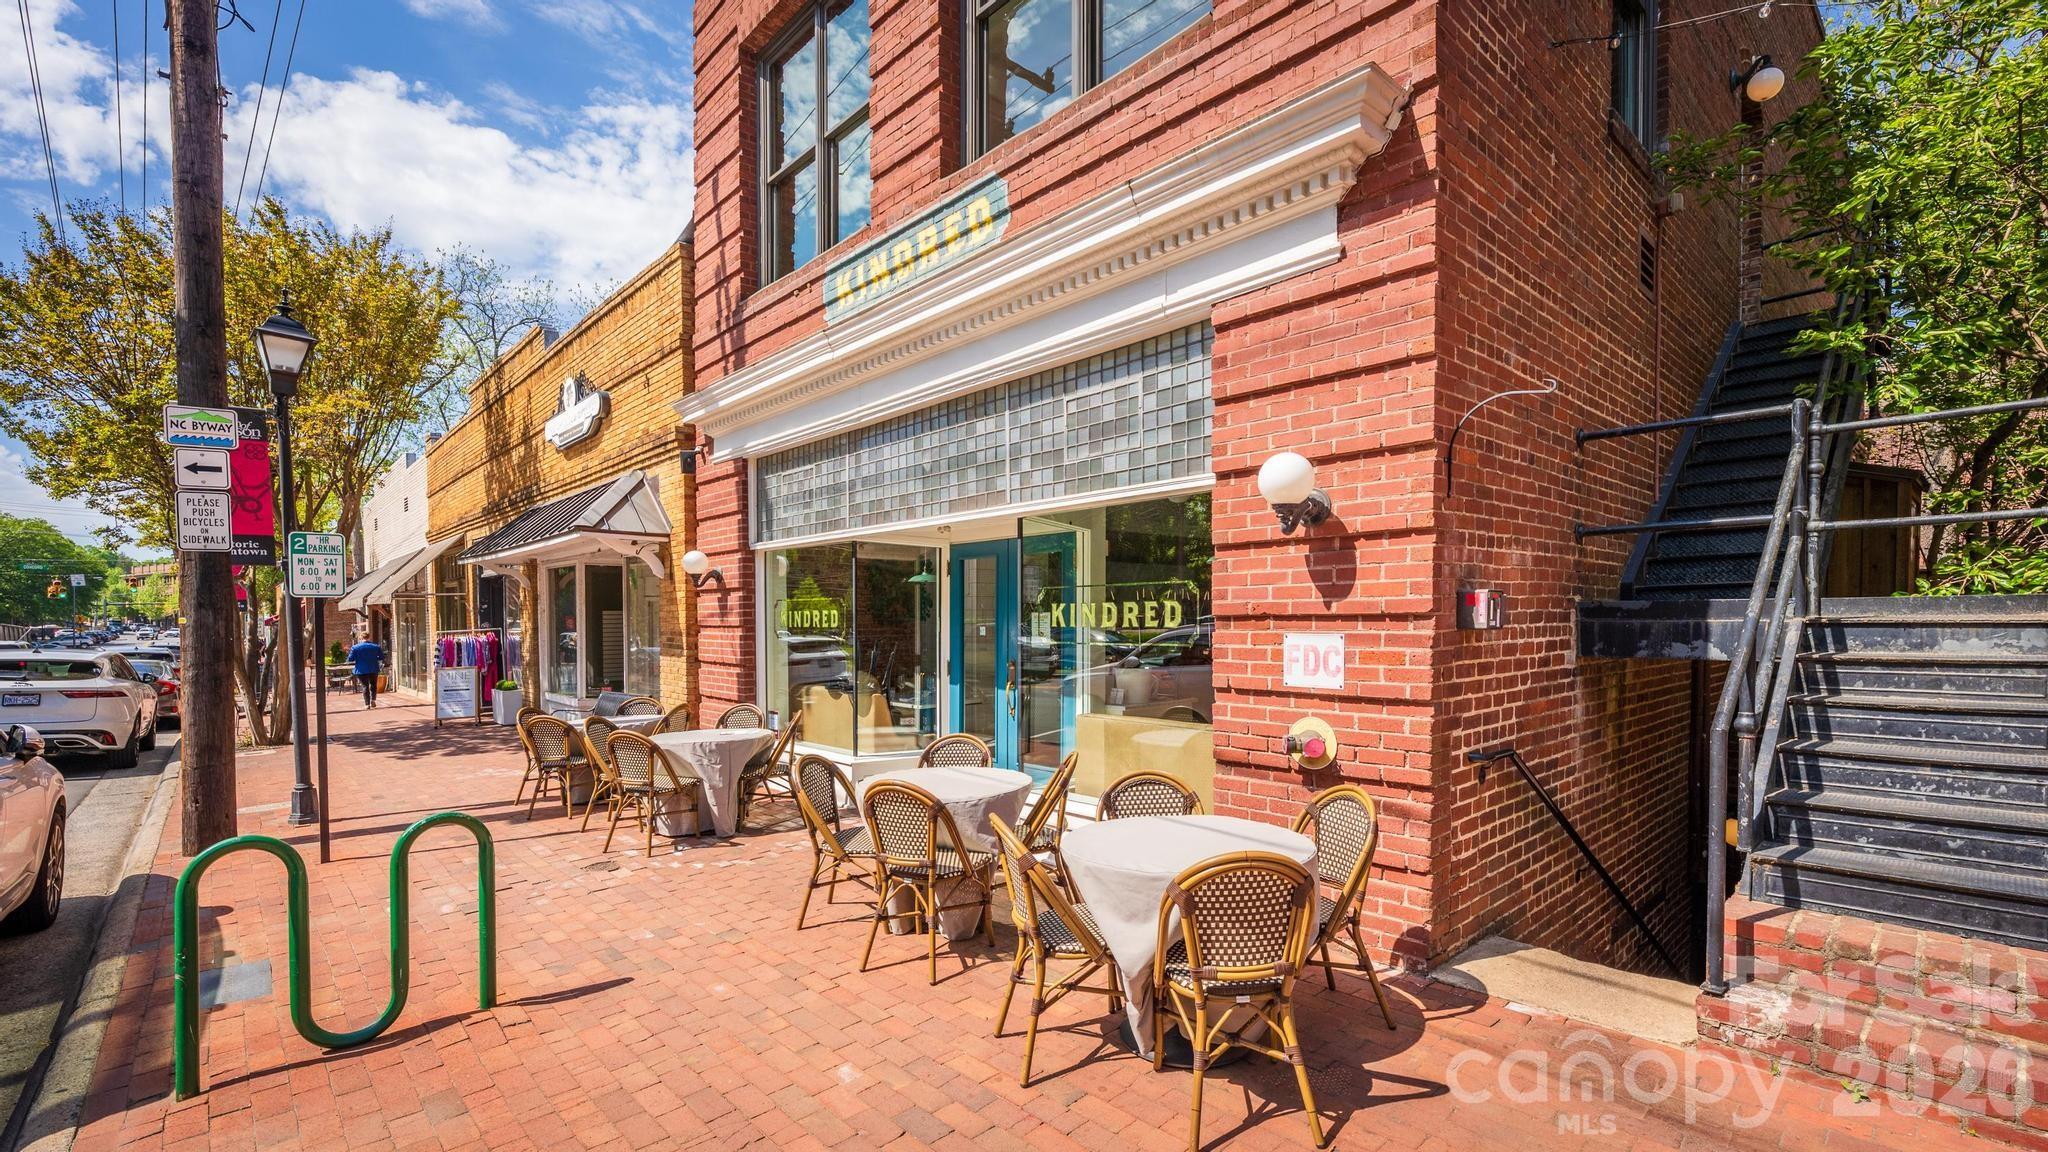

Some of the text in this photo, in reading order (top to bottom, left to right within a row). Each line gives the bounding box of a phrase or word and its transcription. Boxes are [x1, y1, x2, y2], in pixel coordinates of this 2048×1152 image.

[835, 195, 993, 310] KINDRED
[170, 419, 233, 433] NC BYWAY
[186, 498, 220, 508] PLEASE
[192, 508, 216, 517] PUSH
[183, 518, 225, 528] BICYCLES
[182, 535, 227, 545] SIDEWALK
[294, 536, 330, 550] 2 HR
[308, 544, 341, 553] PARKING
[297, 557, 315, 566] MON
[323, 558, 338, 567] SAT
[300, 567, 337, 576] 8:00 AM
[301, 582, 337, 591] 6:00 PM
[780, 609, 839, 628] KINDRED
[1051, 600, 1183, 629] KINDRED
[1284, 643, 1342, 678] FDC
